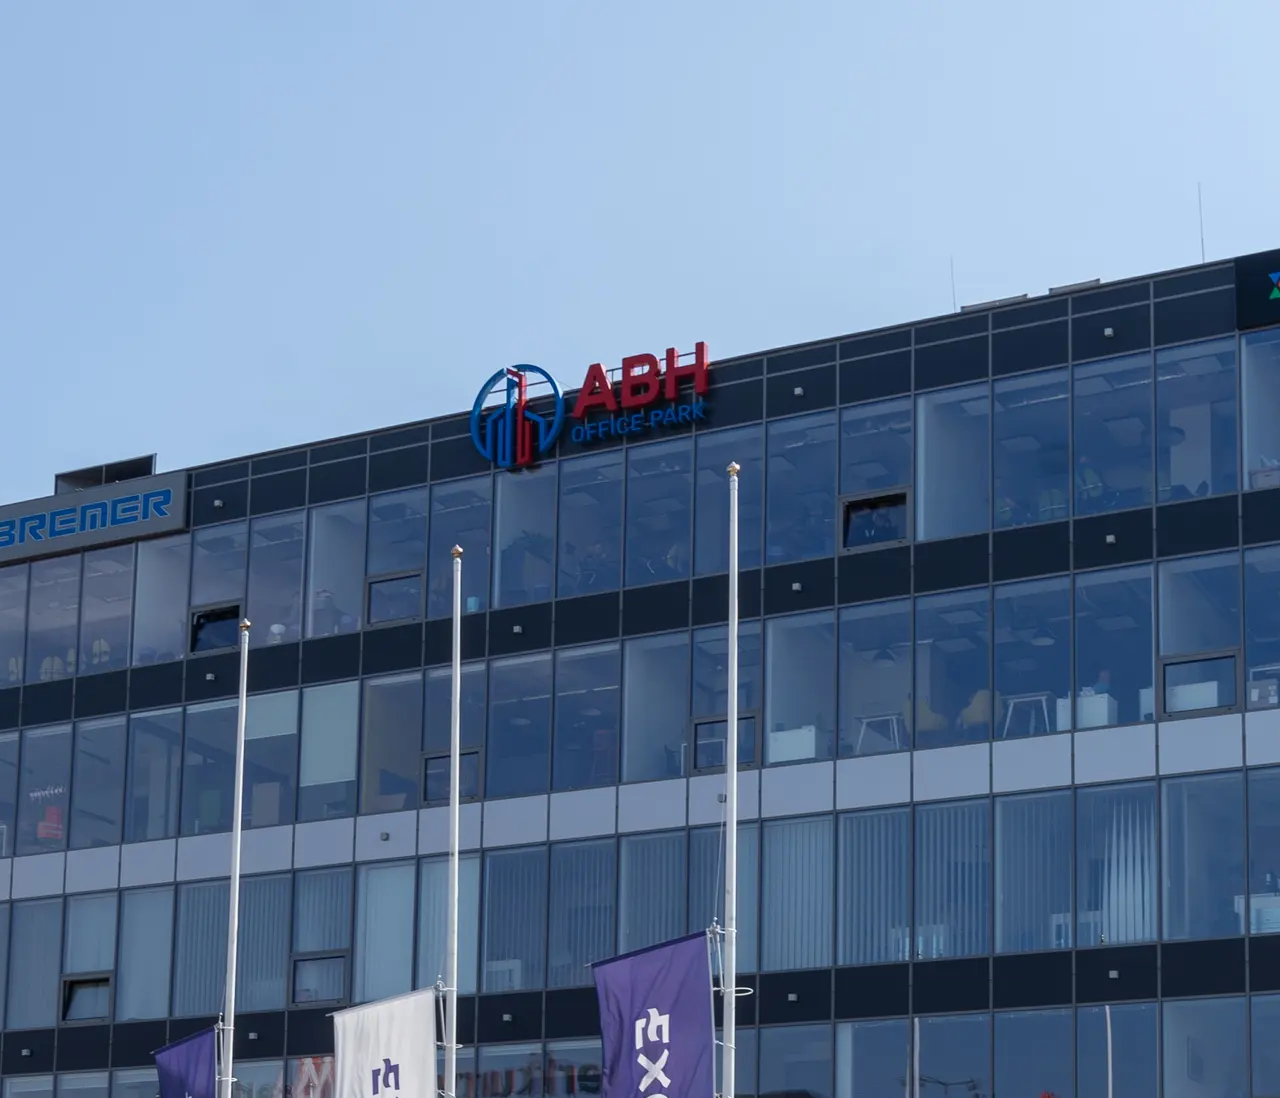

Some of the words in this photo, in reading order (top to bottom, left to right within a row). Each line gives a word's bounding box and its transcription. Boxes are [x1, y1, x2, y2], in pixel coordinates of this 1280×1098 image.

[572, 340, 710, 419] ABH
[570, 412, 644, 444] OFFICE
[648, 401, 707, 430] PARK
